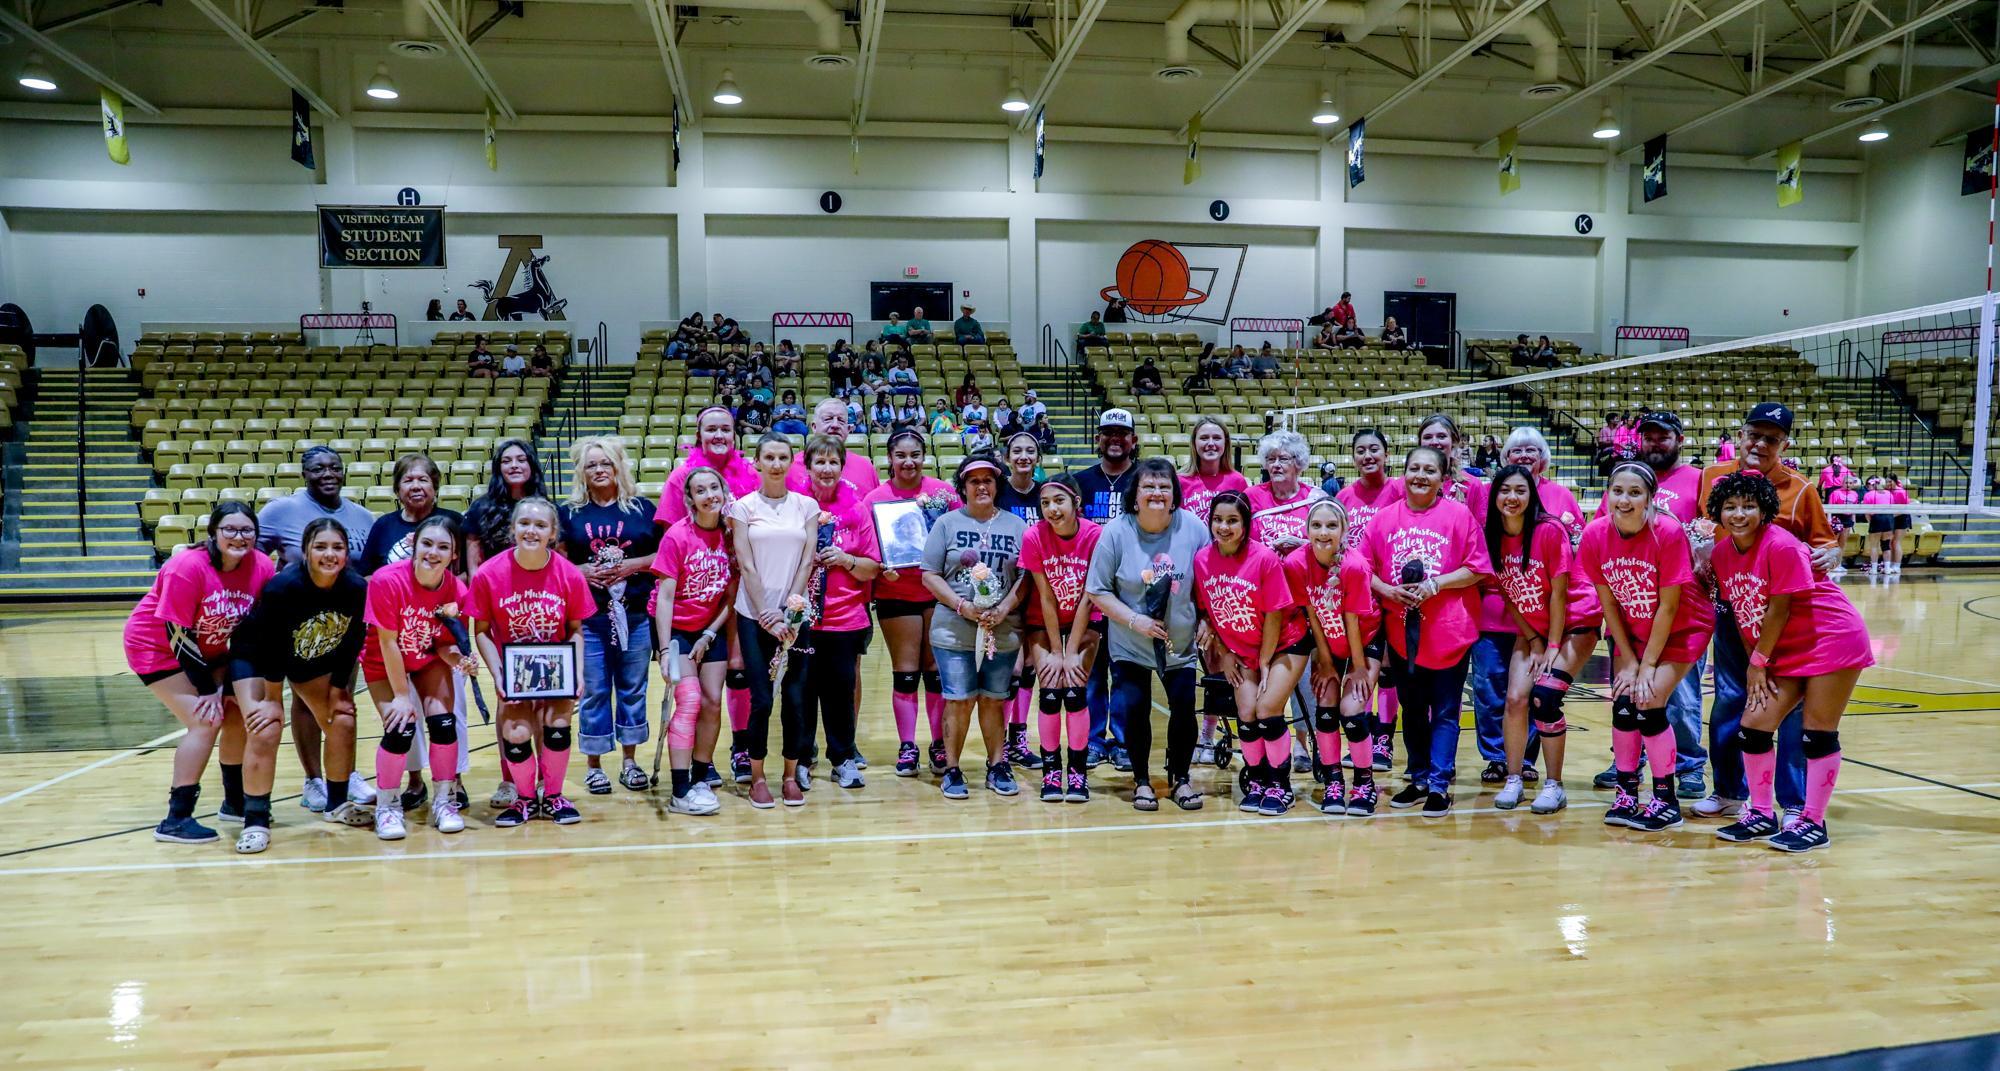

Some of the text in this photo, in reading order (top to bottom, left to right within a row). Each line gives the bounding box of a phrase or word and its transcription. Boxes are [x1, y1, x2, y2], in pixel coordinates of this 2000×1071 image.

[402, 191, 415, 206] H
[1215, 203, 1223, 218] J
[337, 214, 425, 224] VISITING TEAM
[1579, 217, 1589, 231] K
[341, 229, 424, 243] STUDENT
[345, 248, 422, 261] SECTION
[1387, 526, 1450, 545] Lady Mustangs
[1043, 555, 1059, 566] ady
[1616, 556, 1657, 573] Mustangs
[1219, 573, 1257, 591] Mustangs
[499, 588, 566, 608] Lady Mustangs
[506, 601, 542, 618] Volley
[1518, 603, 1545, 614] Cure
[1629, 607, 1653, 619] Cure
[1231, 622, 1256, 633] Cure
